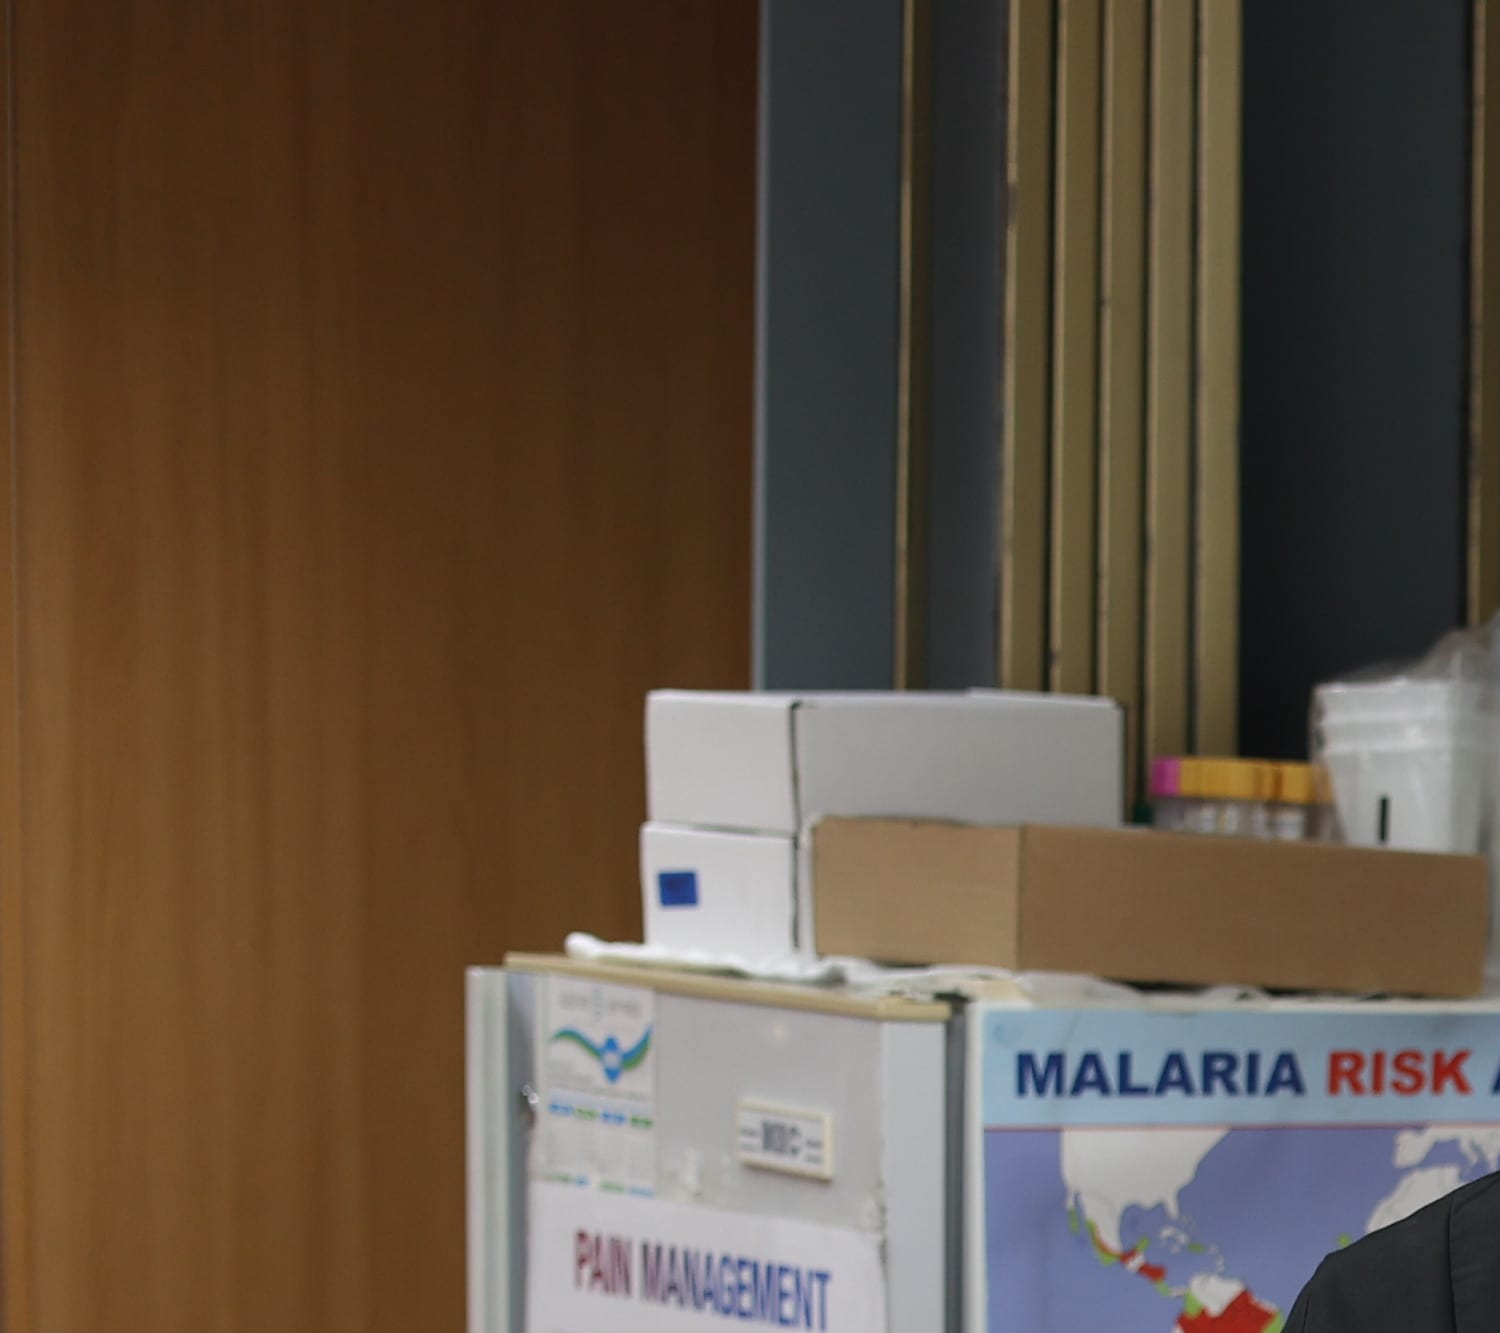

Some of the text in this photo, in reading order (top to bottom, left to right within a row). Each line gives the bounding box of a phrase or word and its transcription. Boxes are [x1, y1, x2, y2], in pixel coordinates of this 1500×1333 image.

[1016, 1050, 1306, 1097] MALARIA
[1327, 1049, 1473, 1096] RISK
[575, 1228, 832, 1333] PAIN MANAGEMENT
